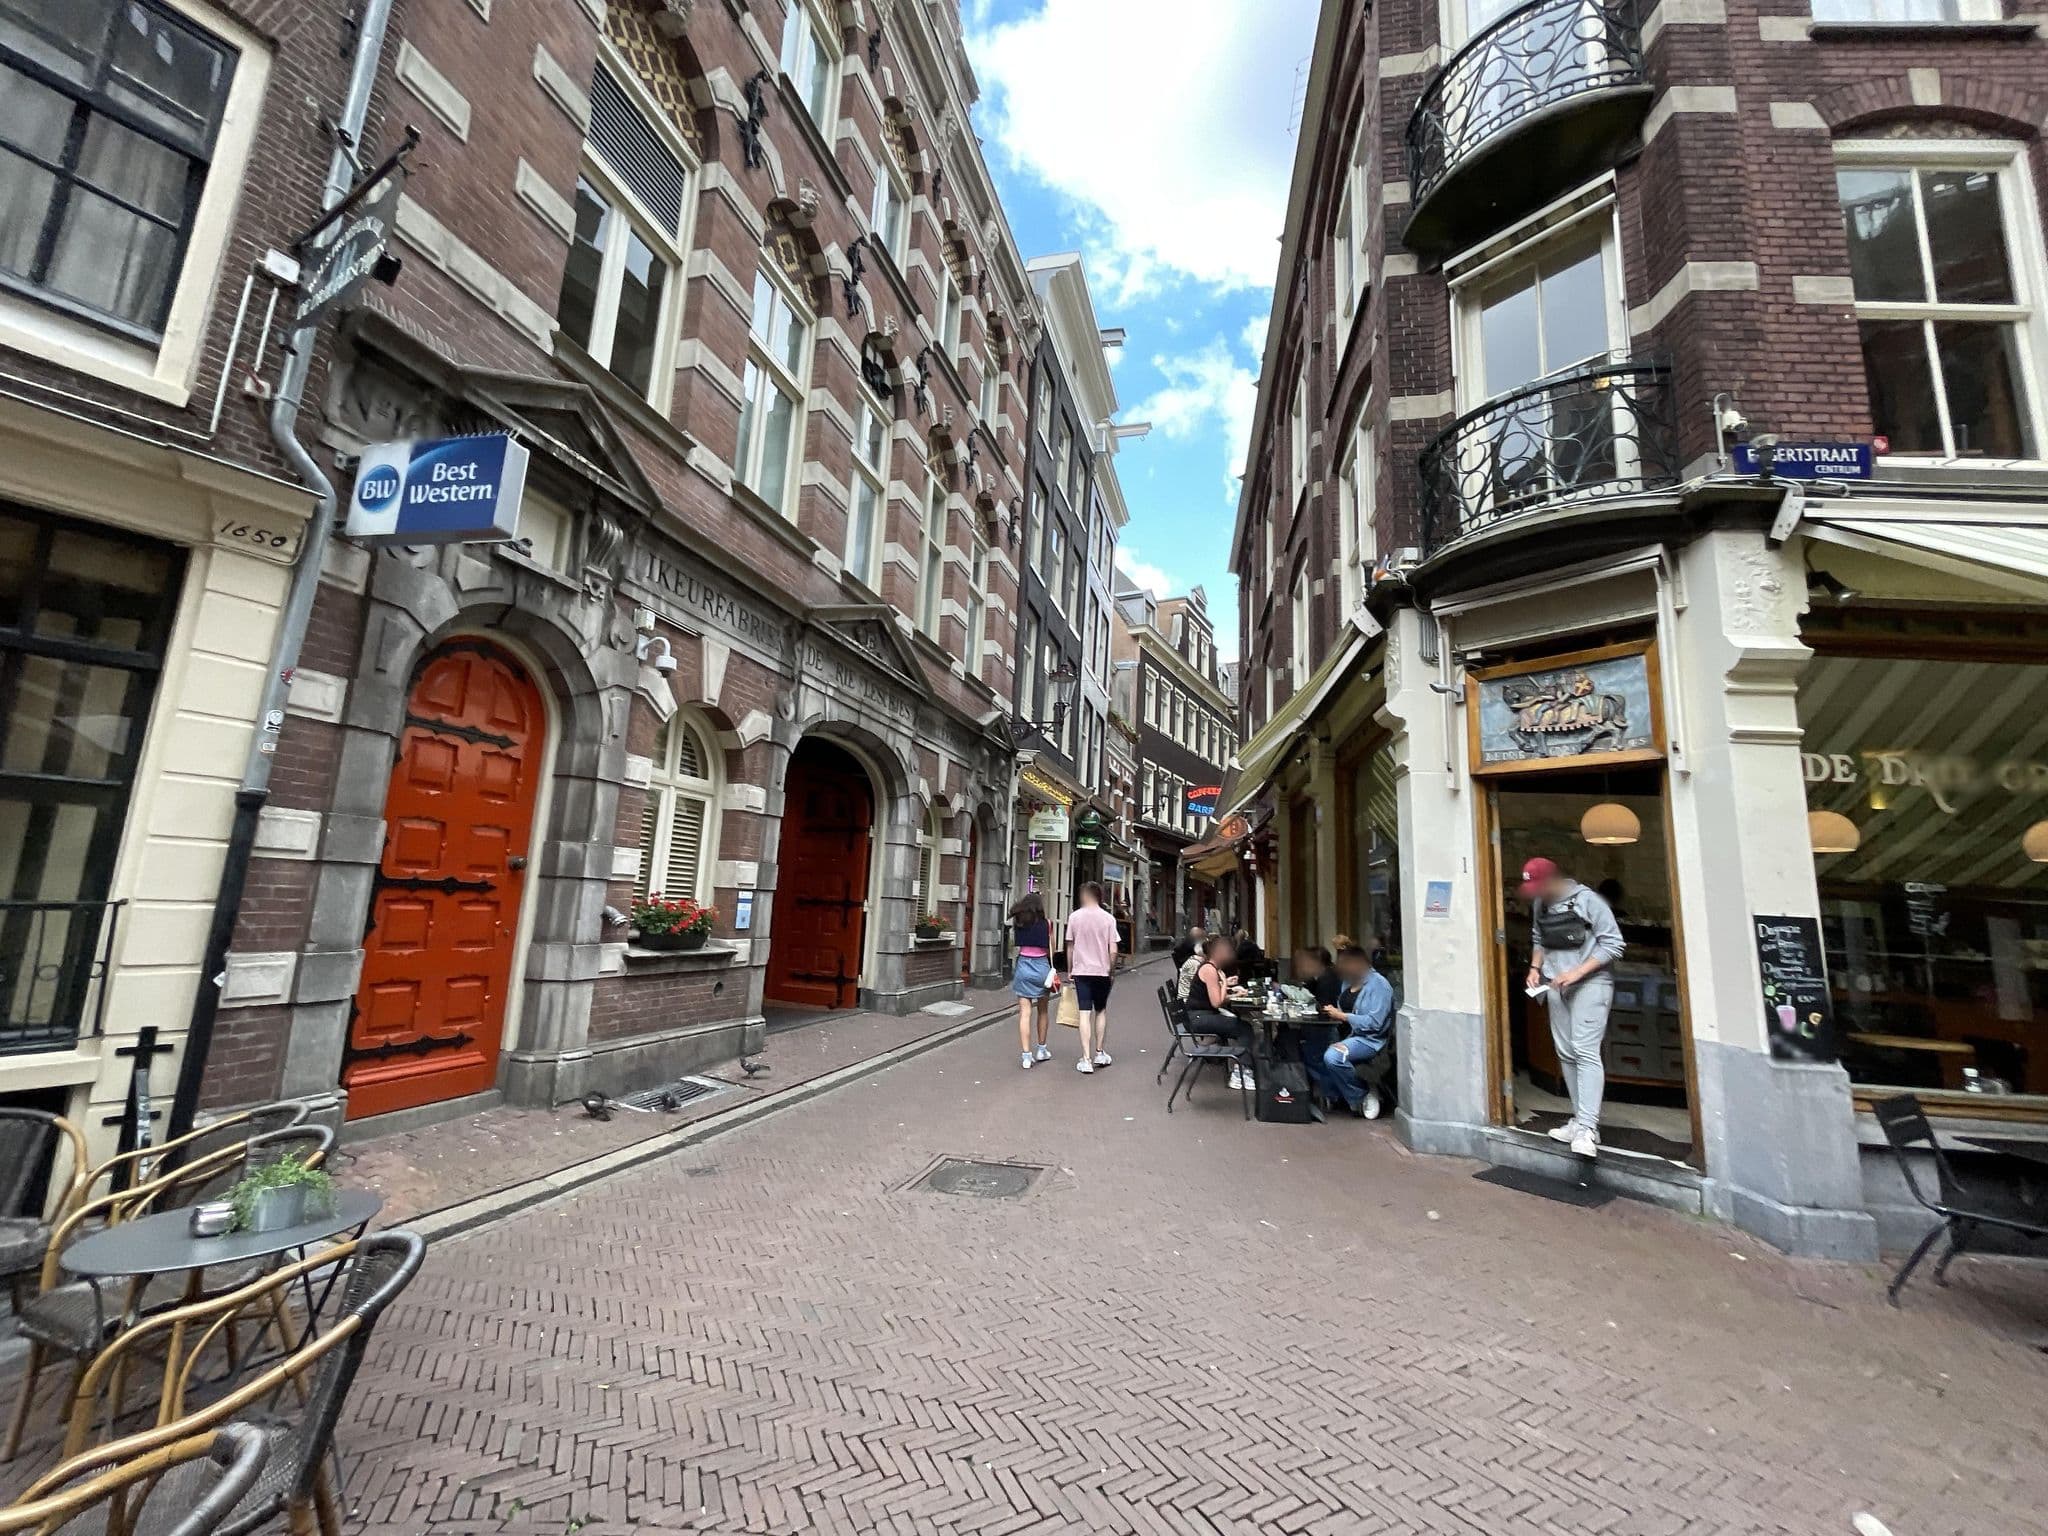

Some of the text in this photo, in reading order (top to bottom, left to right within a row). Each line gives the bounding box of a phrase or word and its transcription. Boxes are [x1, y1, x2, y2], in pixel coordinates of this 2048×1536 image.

[1747, 448, 1859, 462] EERTSTRAAT
[432, 462, 478, 482] Best
[1815, 464, 1861, 474] CENTRUM
[362, 479, 397, 500] BW
[409, 483, 493, 505] Western
[220, 520, 287, 547] 1650
[804, 646, 824, 671] DE
[1800, 752, 1857, 783] DE
